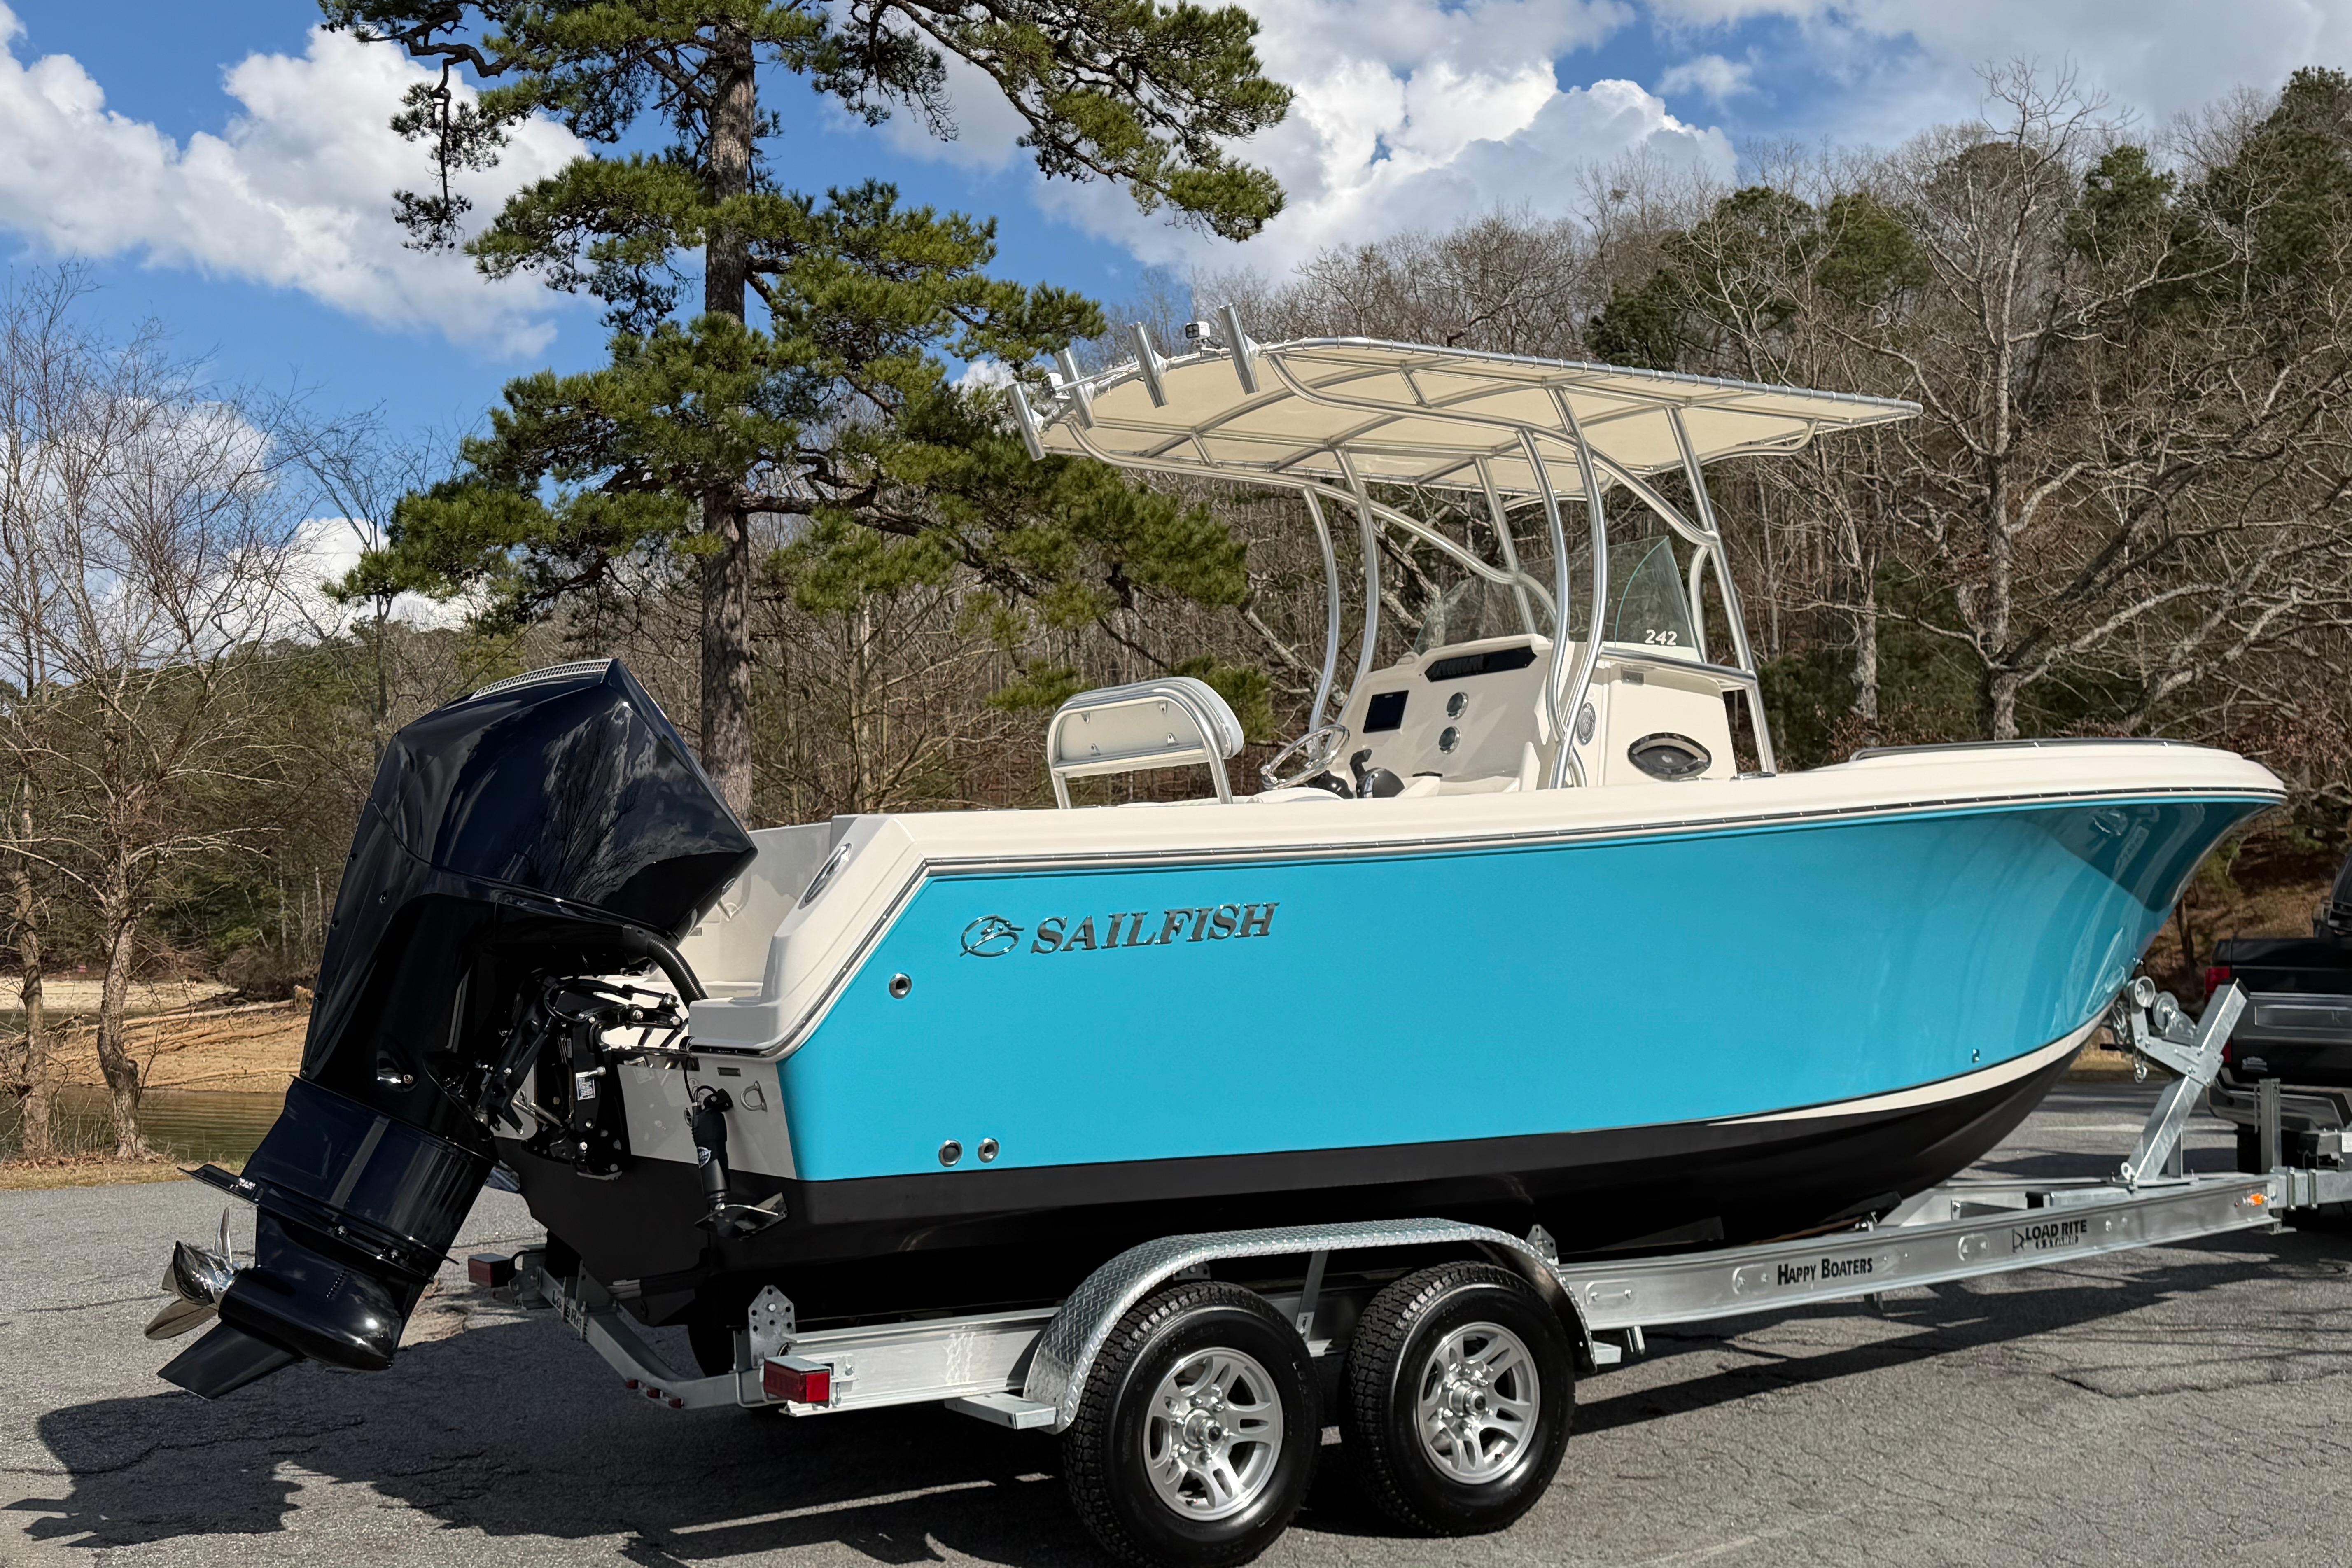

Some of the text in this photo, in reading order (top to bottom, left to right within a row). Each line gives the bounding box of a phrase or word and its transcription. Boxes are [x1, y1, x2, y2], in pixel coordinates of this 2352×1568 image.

[1645, 629, 1677, 645] 242
[1030, 902, 1280, 954] SAILFISH
[2025, 1223, 2058, 1241] LOAD
[2061, 1219, 2087, 1235] RITE
[1778, 1258, 1873, 1286] HAPPY BOATERS
